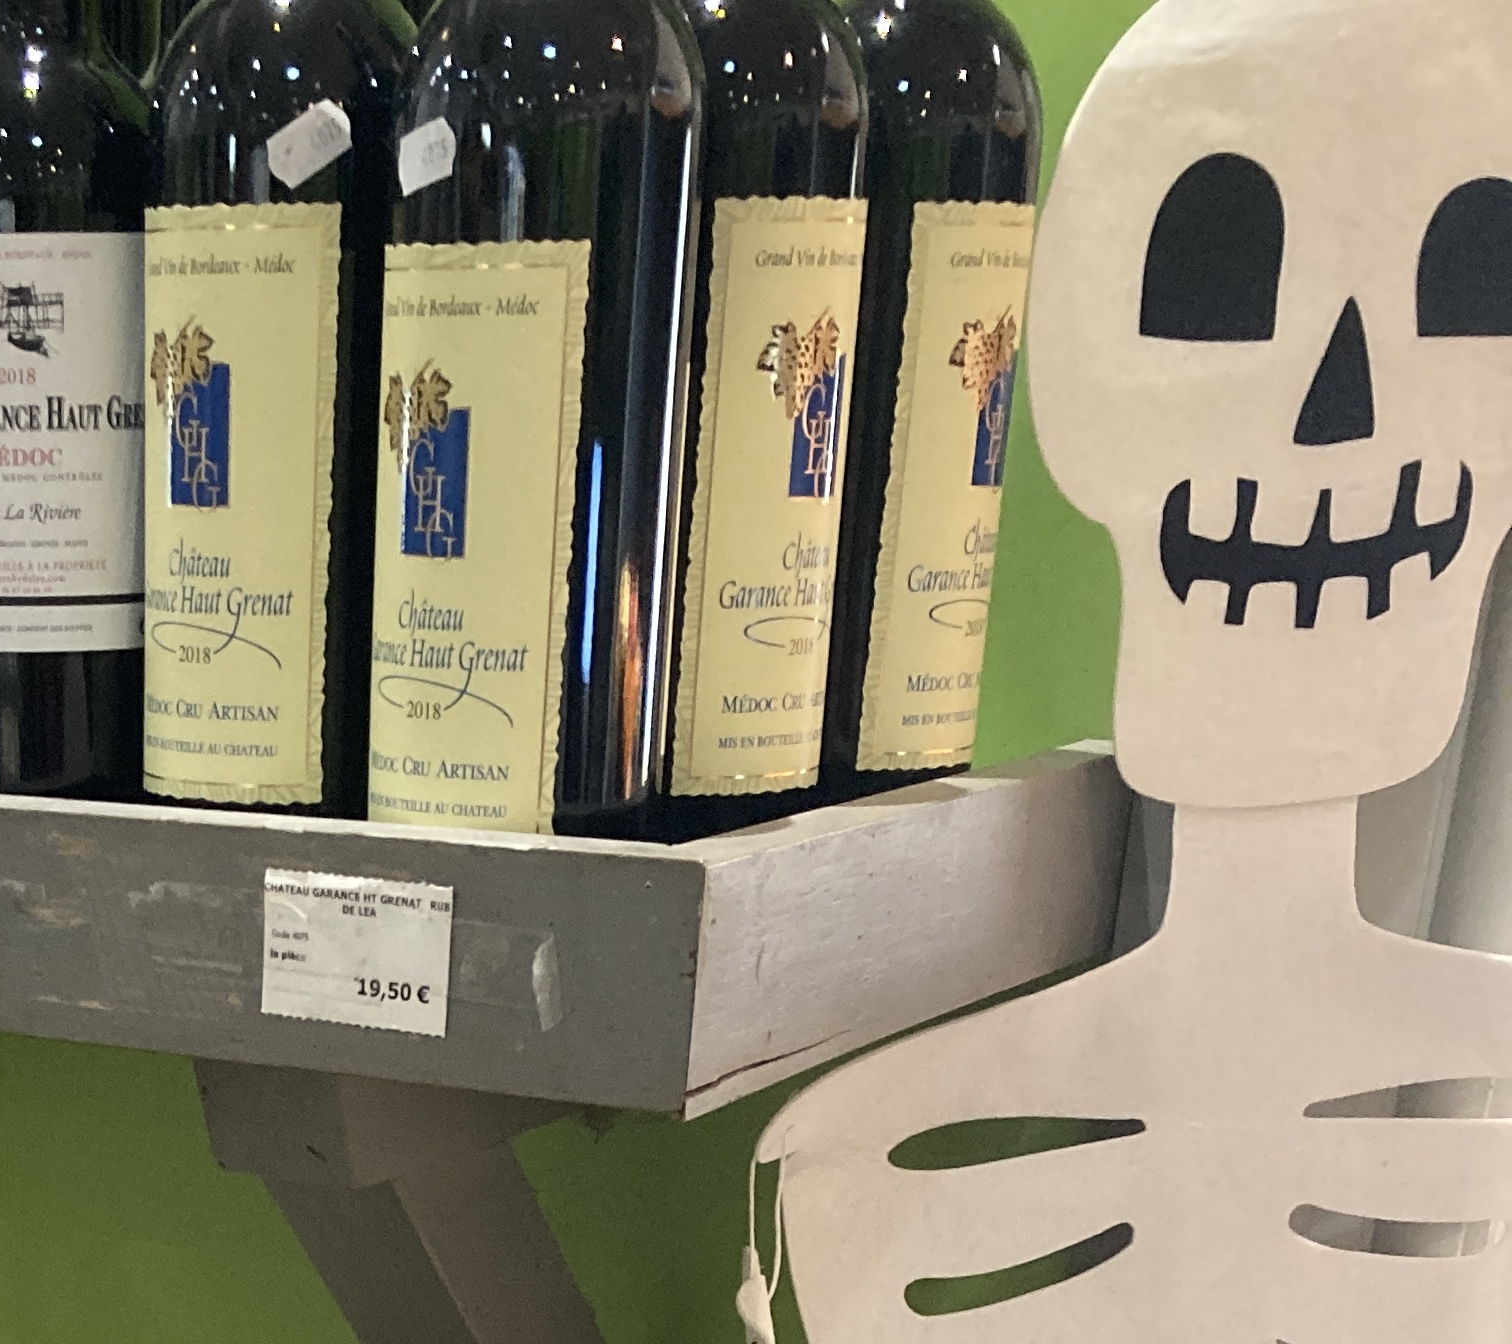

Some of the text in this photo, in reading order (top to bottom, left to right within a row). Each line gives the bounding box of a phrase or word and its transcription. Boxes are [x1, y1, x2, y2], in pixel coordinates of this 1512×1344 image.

[253, 252, 296, 275] Médoc
[495, 293, 540, 316] Médoc
[45, 394, 103, 433] HAUT
[3, 503, 25, 521] La
[29, 502, 82, 525] Rivière
[168, 536, 232, 585] Château
[180, 585, 294, 617] Haut Grenat
[719, 578, 792, 611] Garance
[398, 588, 465, 637] Château
[178, 644, 212, 665] 2018
[409, 638, 529, 673] Haut Grenat
[906, 672, 955, 693] MÉDOC
[208, 701, 280, 722] ARTISAN
[406, 700, 442, 721] 2018
[721, 689, 778, 715] MÉDOC
[402, 755, 510, 782] CRU ARTISAN
[451, 802, 508, 819] CHATEAU
[263, 881, 310, 898] CHATEAU
[312, 886, 361, 902] GARANCE
[363, 893, 378, 904] HT
[380, 894, 423, 910] GRENAT
[341, 904, 378, 918] DE LEA
[356, 976, 431, 1004] 19,50 €
